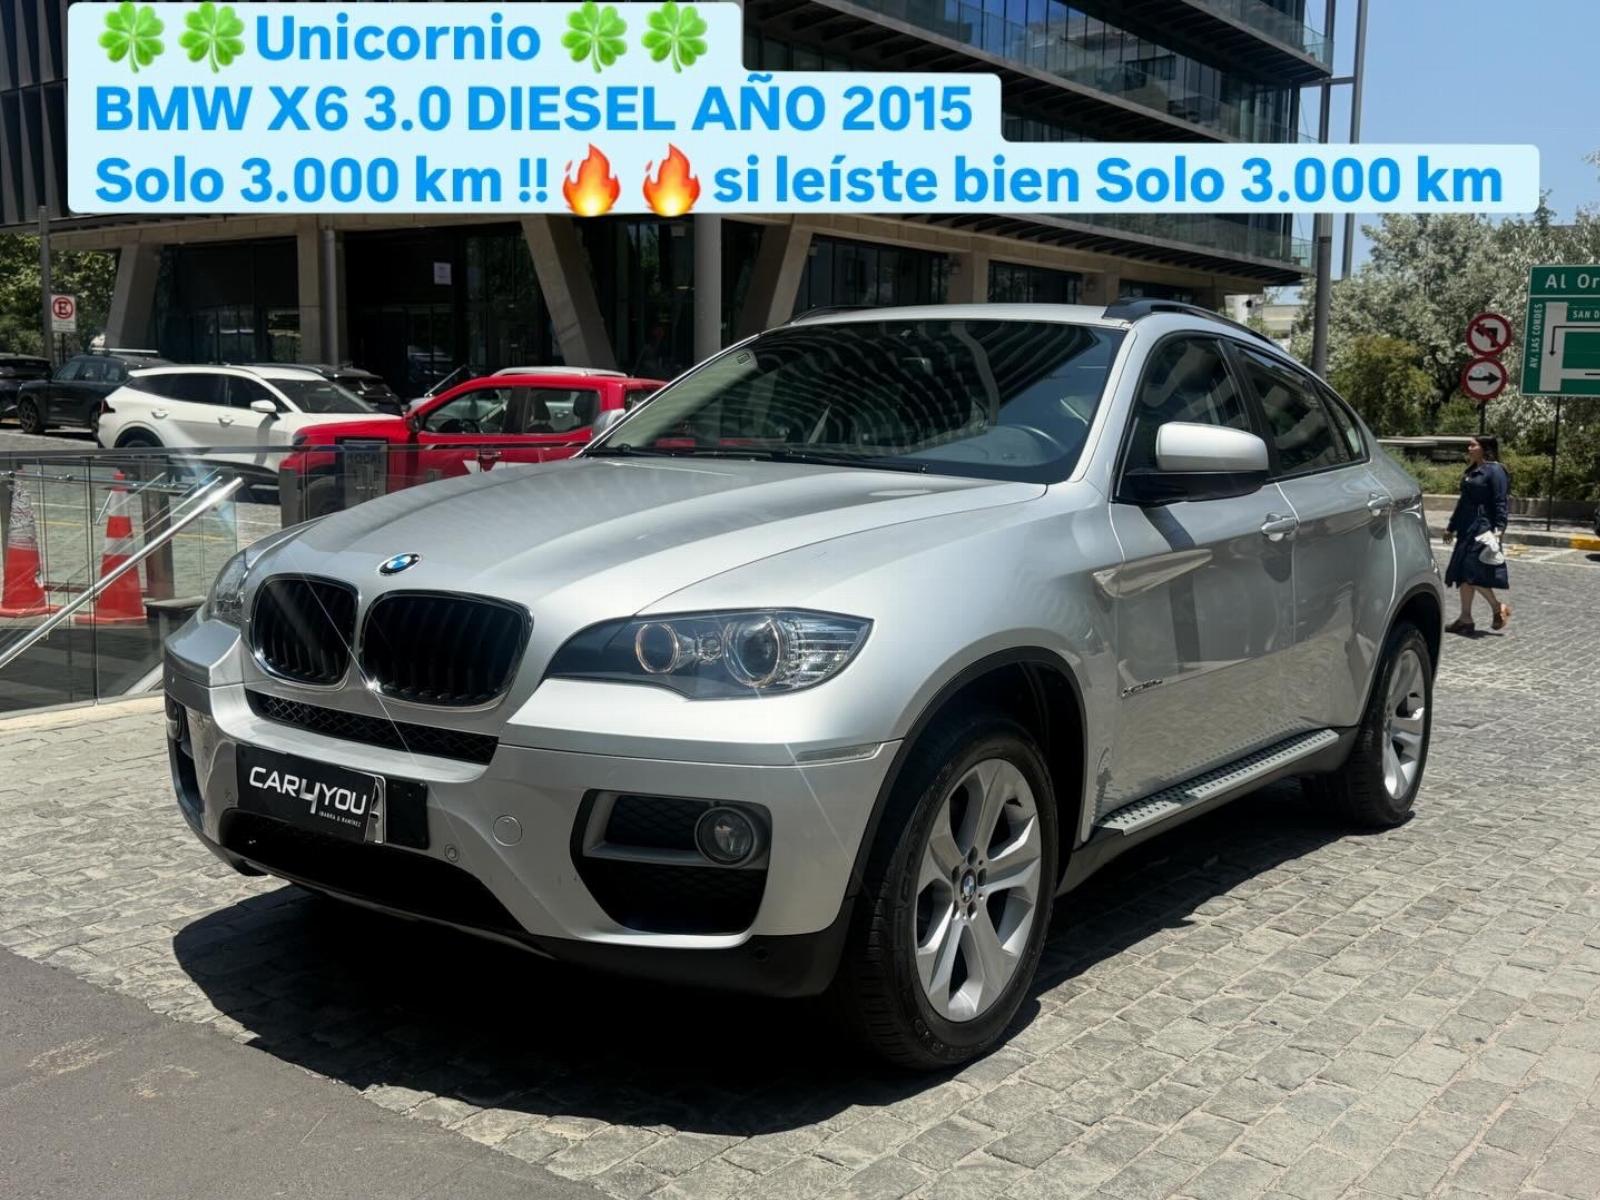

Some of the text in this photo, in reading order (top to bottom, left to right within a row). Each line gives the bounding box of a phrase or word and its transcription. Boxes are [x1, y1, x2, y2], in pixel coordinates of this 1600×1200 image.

[1545, 273, 1566, 289] Al
[1572, 310, 1591, 319] SAN
[1529, 303, 1543, 368] AV. LAS CONDES
[249, 766, 366, 815] CAR4YOU
